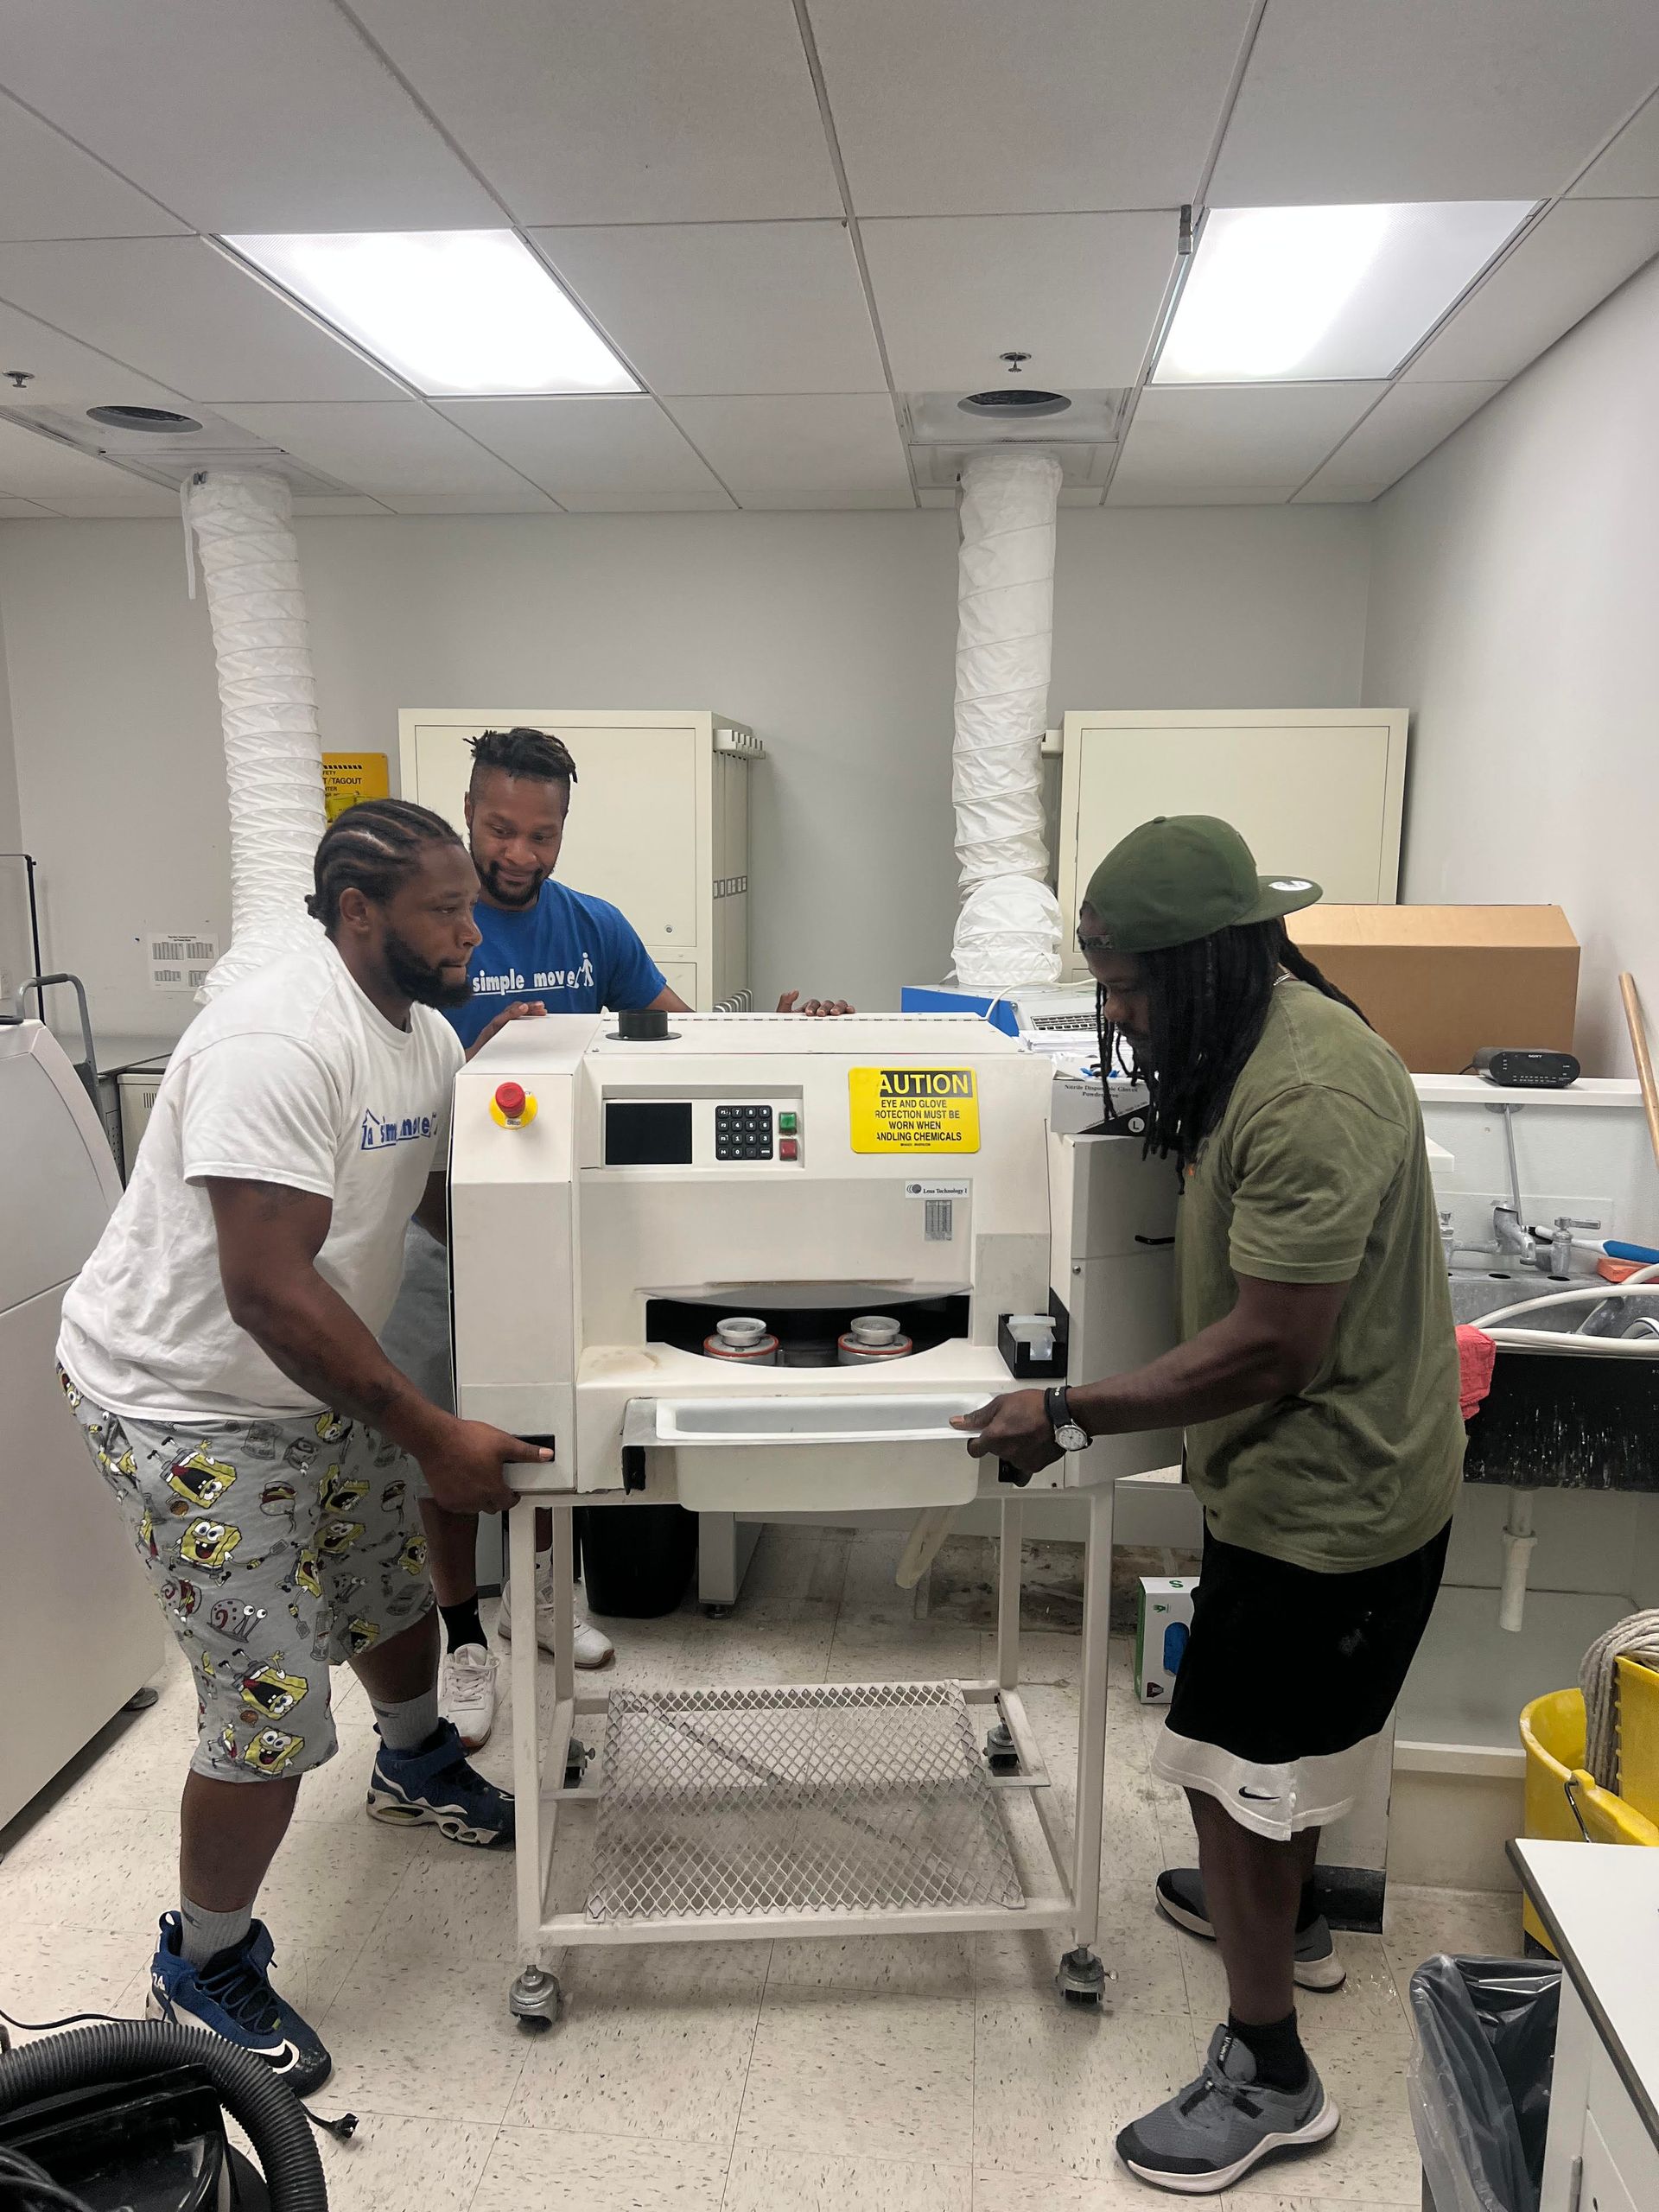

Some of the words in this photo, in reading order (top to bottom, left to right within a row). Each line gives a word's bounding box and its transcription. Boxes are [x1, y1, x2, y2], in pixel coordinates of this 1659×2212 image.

[473, 968, 524, 996] simple
[533, 969, 575, 988] move
[879, 1074, 969, 1094] AUTION
[881, 1099, 897, 1109] EYE
[899, 1099, 917, 1109] AND
[918, 1099, 947, 1109] GLOVE
[875, 1109, 922, 1119] ROTECTION
[924, 1109, 946, 1119] MUST
[949, 1109, 960, 1119] BE
[889, 1121, 914, 1130] WORN
[917, 1121, 941, 1130] WHEN
[1133, 1120, 1140, 1130] L
[876, 1132, 912, 1141] ANDLING
[913, 1132, 962, 1141] CHEMICALS
[152, 1972, 166, 1992] 24
